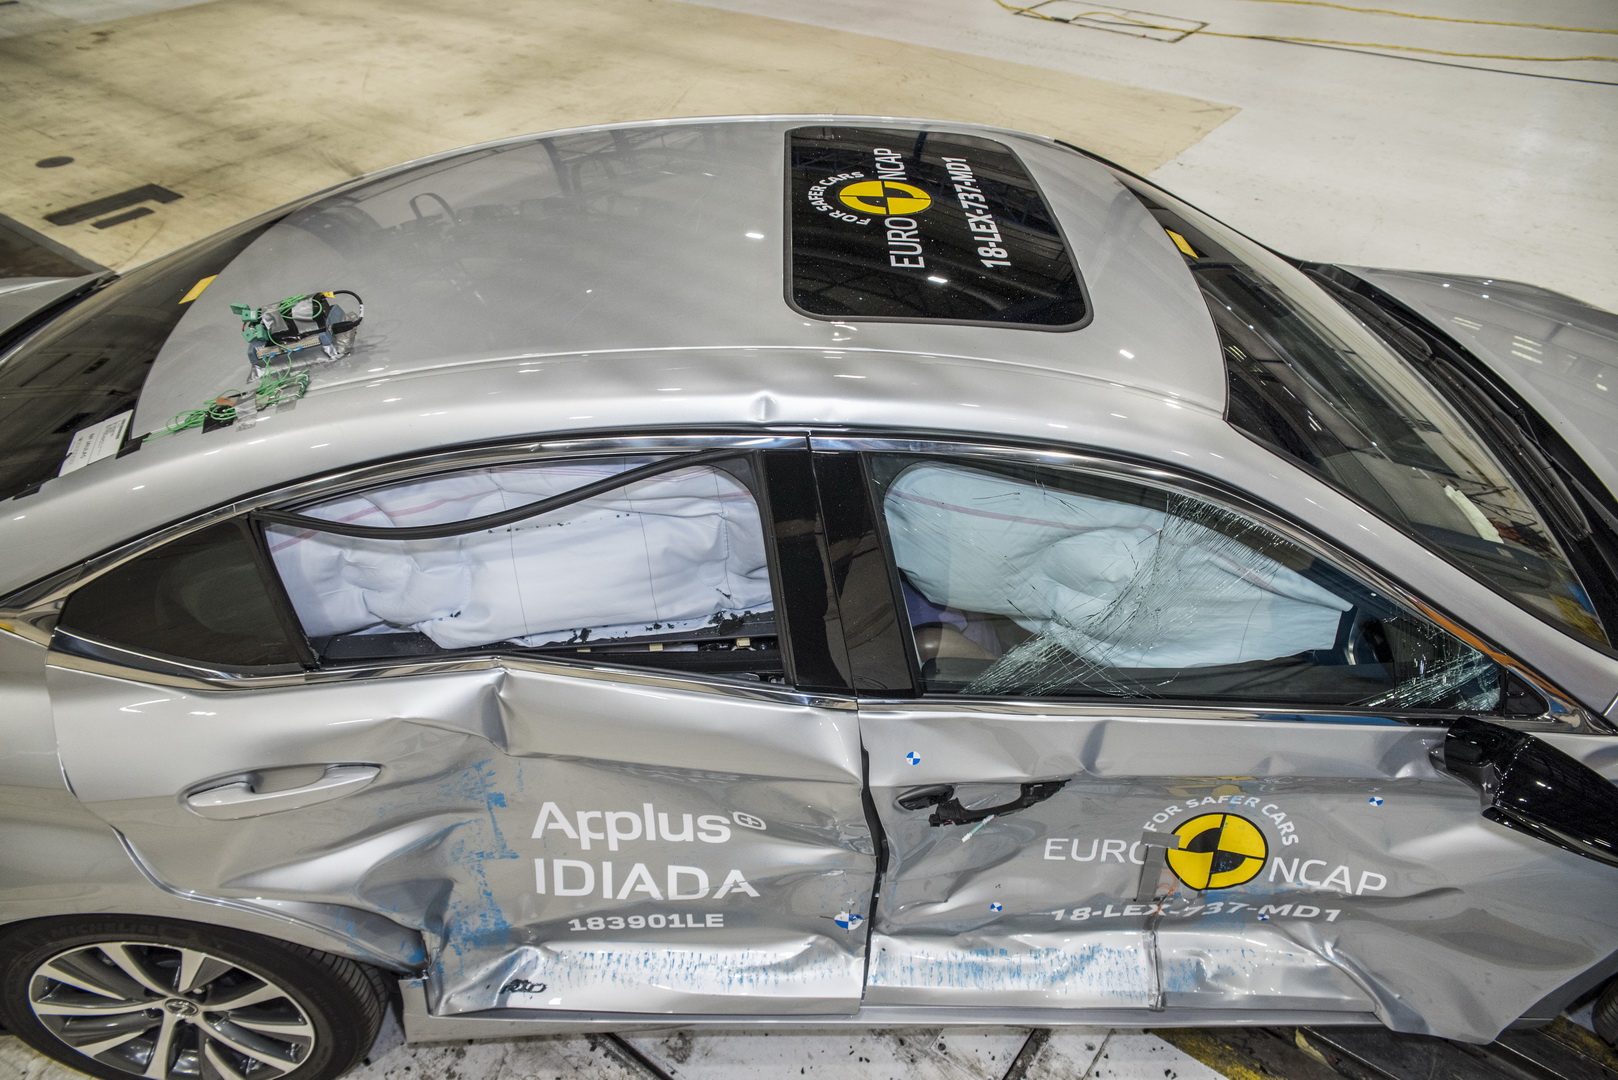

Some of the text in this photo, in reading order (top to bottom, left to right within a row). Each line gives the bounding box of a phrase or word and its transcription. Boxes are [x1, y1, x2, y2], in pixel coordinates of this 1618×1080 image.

[808, 171, 871, 226] FOR SAFER CARS
[873, 148, 926, 269] EURO NCAP
[941, 156, 1012, 268] 18-LEX-737-MD1
[531, 801, 732, 851] Applus
[1143, 795, 1299, 846] FOR SAFER CARS
[534, 858, 761, 900] IDIADA
[1268, 857, 1388, 896] NCAP
[567, 913, 724, 932] 183901LE
[1050, 901, 1342, 923] 18-LEX-737-MD1
